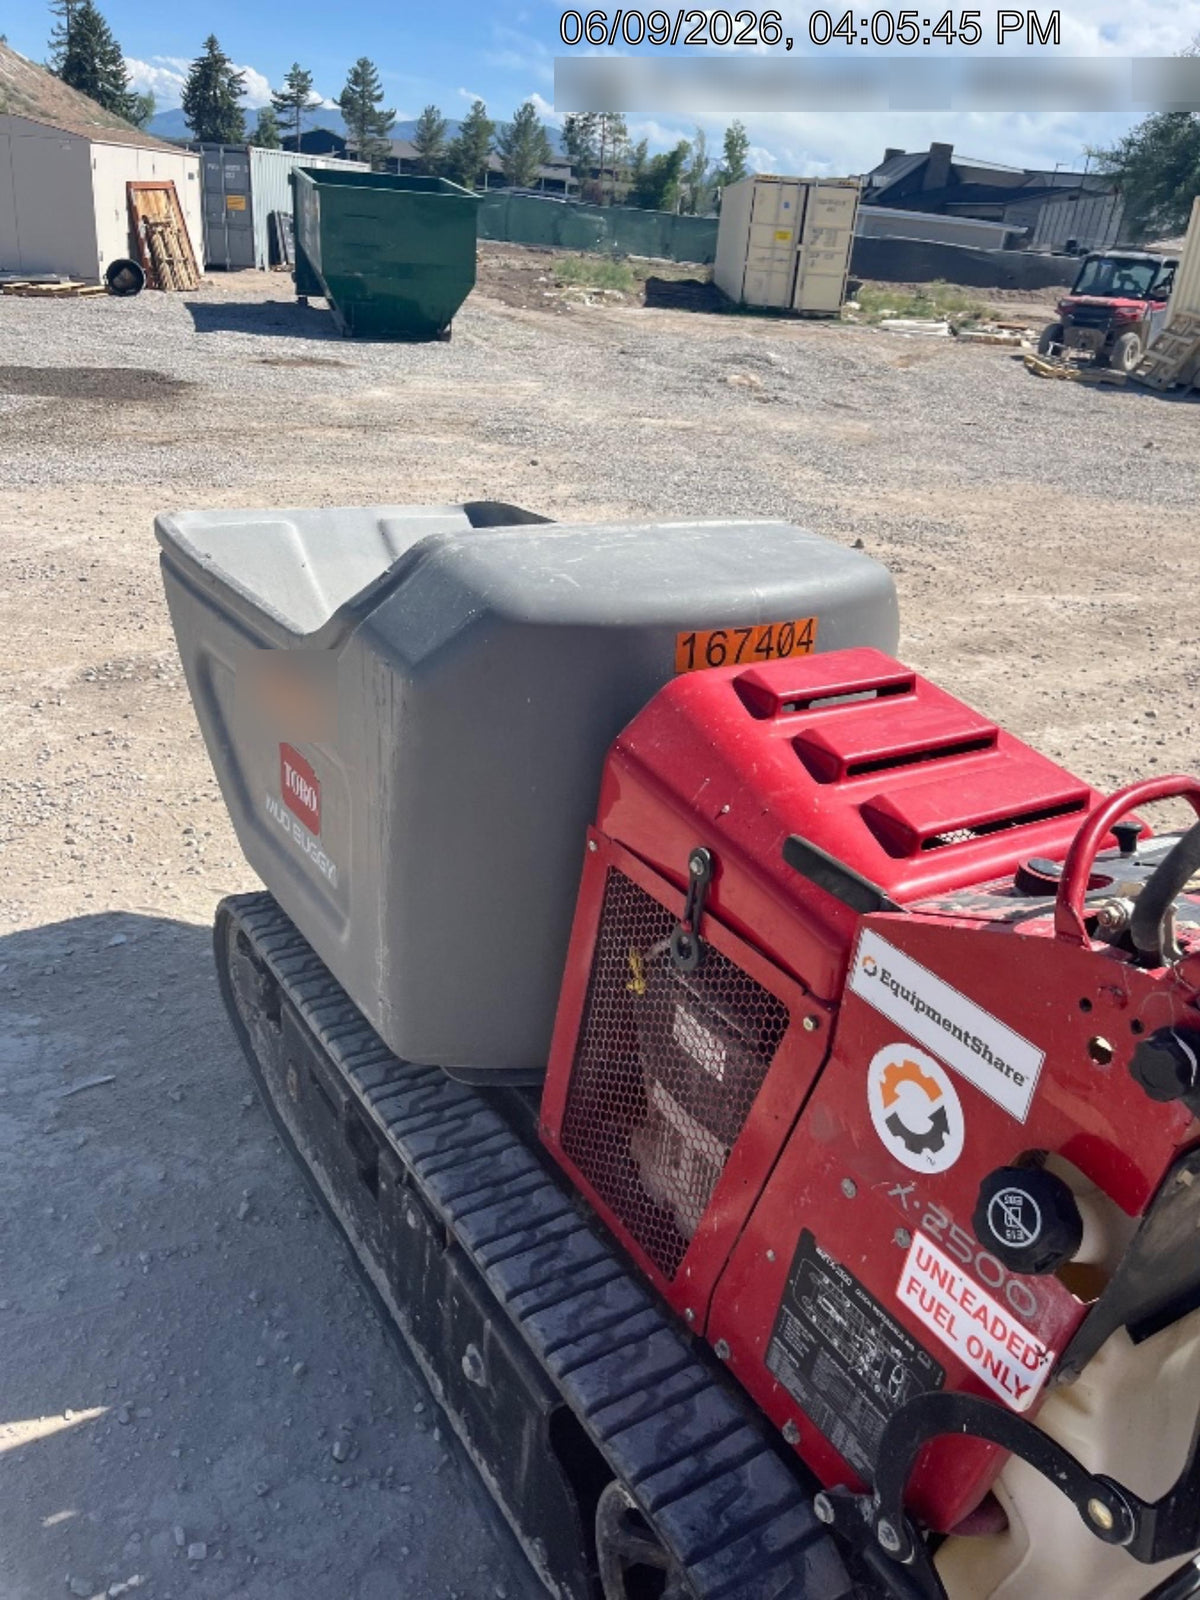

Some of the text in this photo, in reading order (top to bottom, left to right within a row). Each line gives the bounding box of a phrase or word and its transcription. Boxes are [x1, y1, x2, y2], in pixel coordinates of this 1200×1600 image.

[682, 618, 814, 669] 167404
[284, 761, 317, 812] TORO
[265, 793, 339, 889] MUD BUGGY
[880, 968, 1025, 1087] EquipmentShare
[906, 1276, 957, 1341] FUEL
[966, 1335, 1031, 1400] ONLY
[916, 1246, 1041, 1372] UNLEADED
